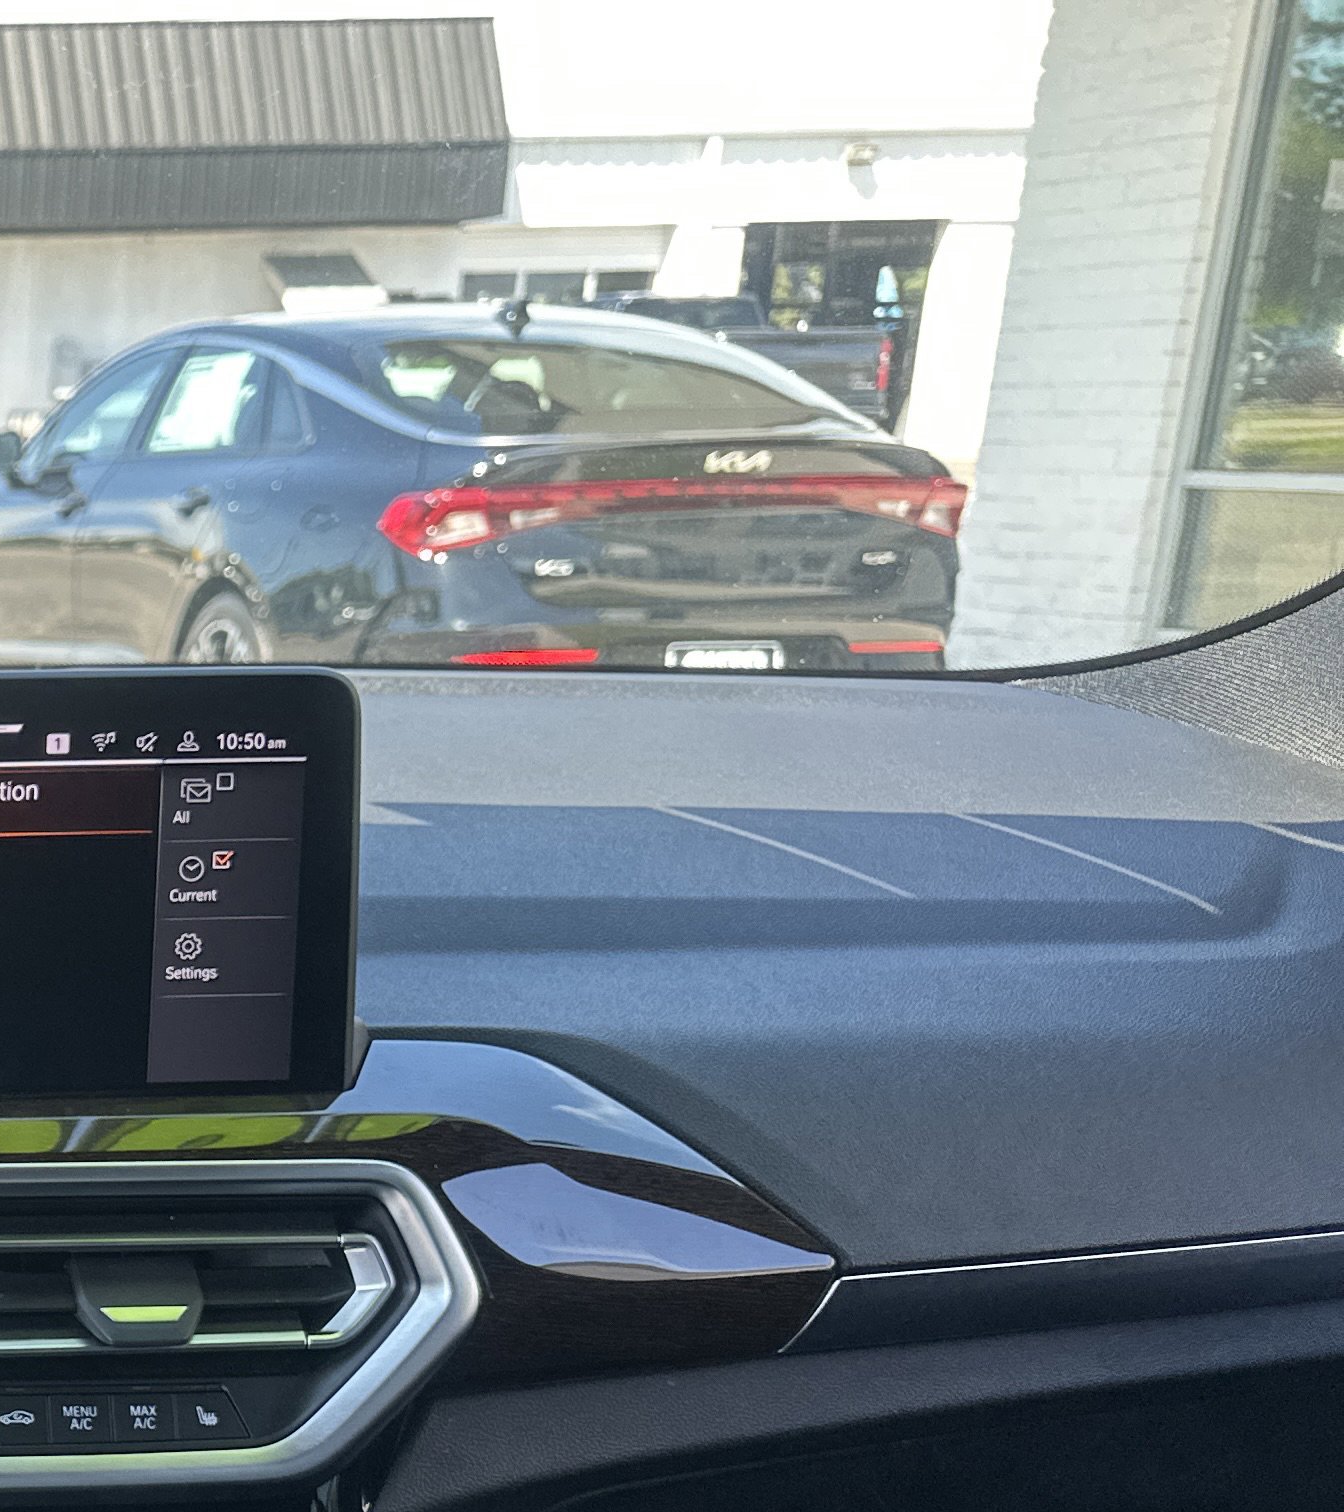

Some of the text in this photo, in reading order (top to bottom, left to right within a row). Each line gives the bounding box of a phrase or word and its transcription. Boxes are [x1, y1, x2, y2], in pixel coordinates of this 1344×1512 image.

[216, 732, 287, 750] 10:50 am
[171, 810, 191, 825] All
[169, 888, 218, 902] Current
[165, 966, 219, 982] Settings
[62, 1405, 98, 1418] MENU
[129, 1405, 158, 1417] MAX
[69, 1417, 93, 1431] A/C
[133, 1417, 156, 1430] A/C
